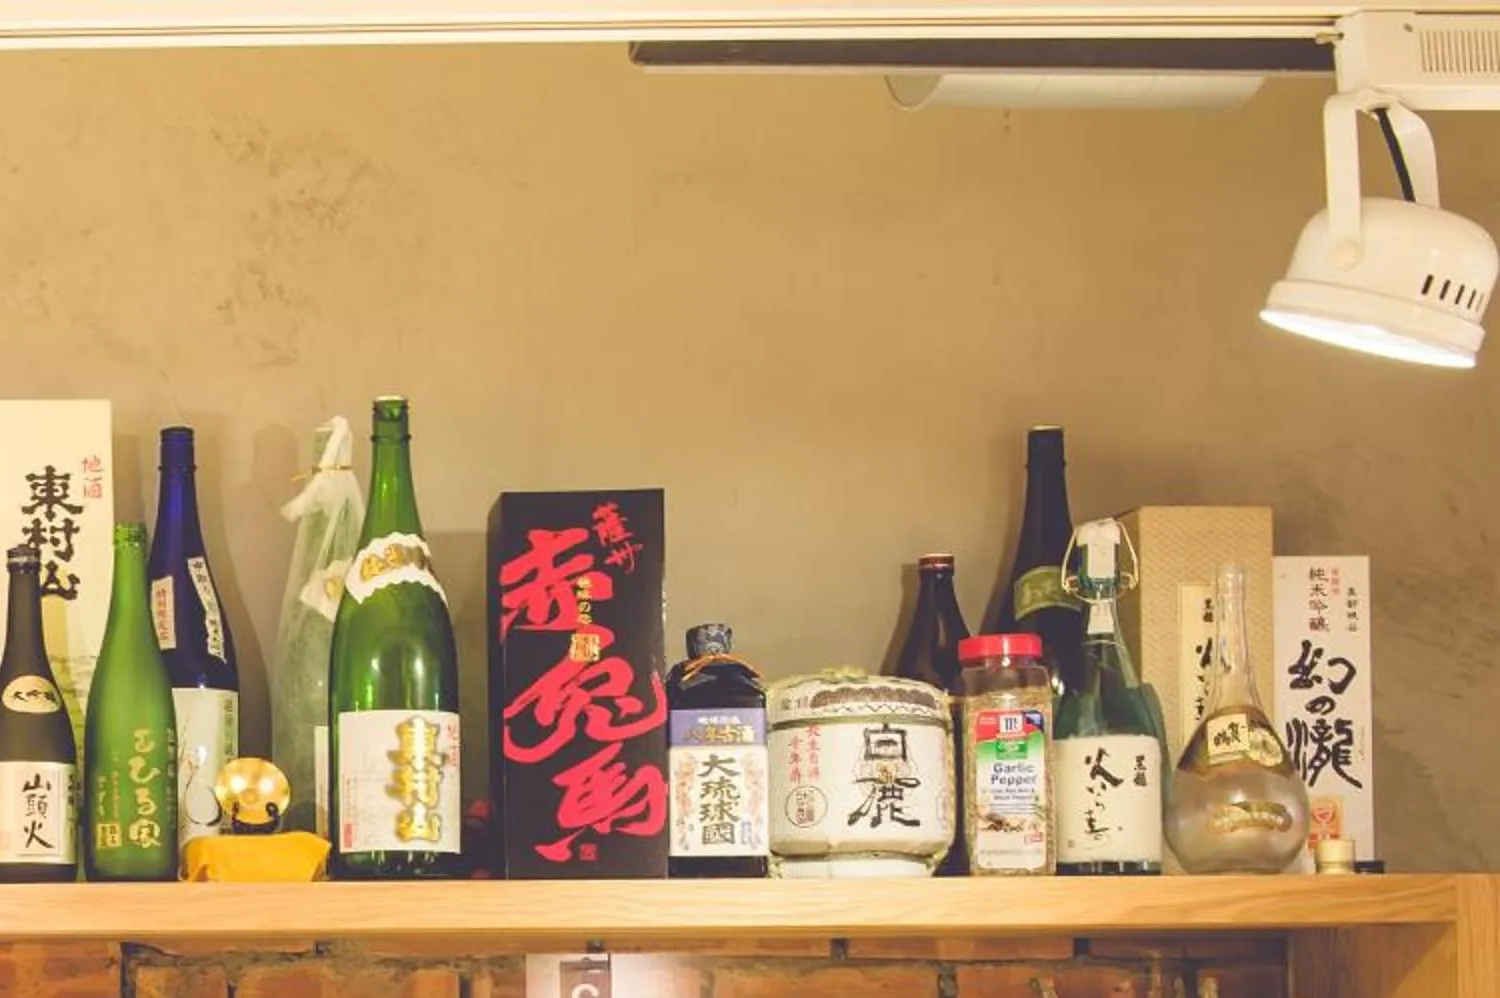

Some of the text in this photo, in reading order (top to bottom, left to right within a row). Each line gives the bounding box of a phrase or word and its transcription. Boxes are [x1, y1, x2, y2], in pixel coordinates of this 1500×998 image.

[21, 465, 83, 601] 東村山
[500, 527, 669, 863] 赤兎馬
[1286, 639, 1363, 790] 幻の瀧
[22, 773, 73, 849] 山頭火
[854, 724, 921, 828] 白鹿
[991, 774, 1038, 786] Pepper
[993, 762, 1035, 773] Garlic
